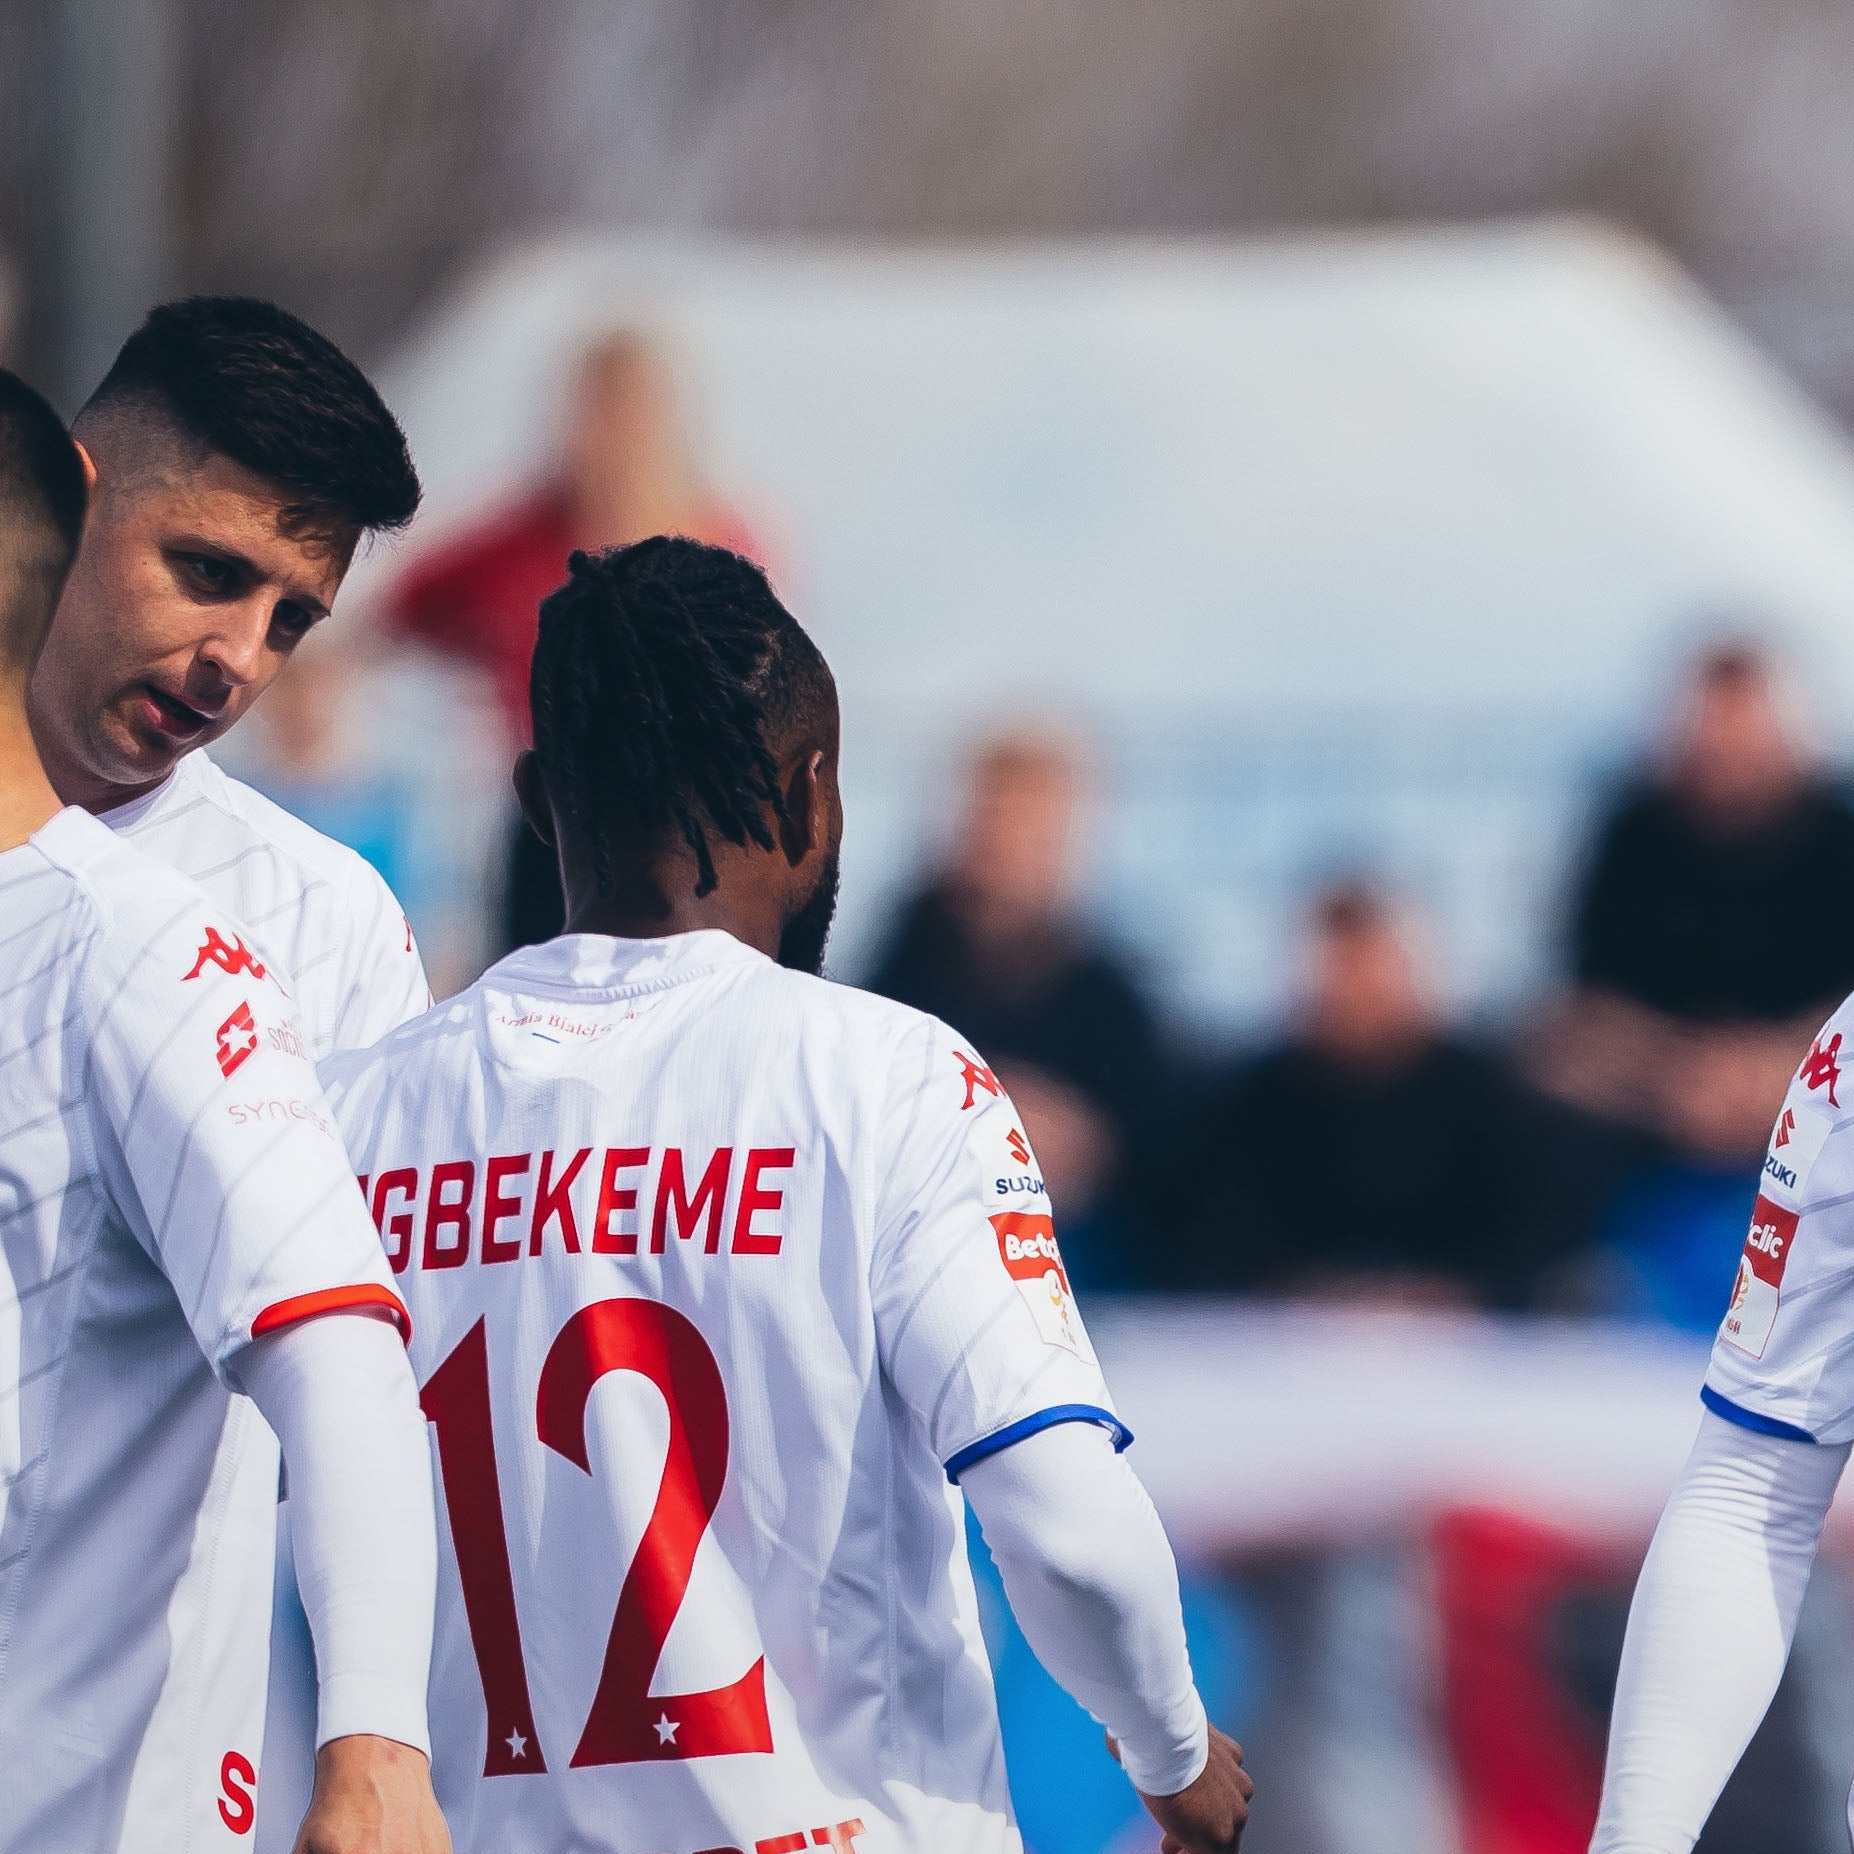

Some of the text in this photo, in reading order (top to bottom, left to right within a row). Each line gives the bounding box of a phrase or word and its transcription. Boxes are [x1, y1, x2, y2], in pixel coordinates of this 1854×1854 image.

[356, 1146, 797, 1275] GBEKEME
[1765, 1155, 1797, 1189] ZUKI
[1748, 1223, 1784, 1258] clic
[419, 1297, 775, 1778] 12
